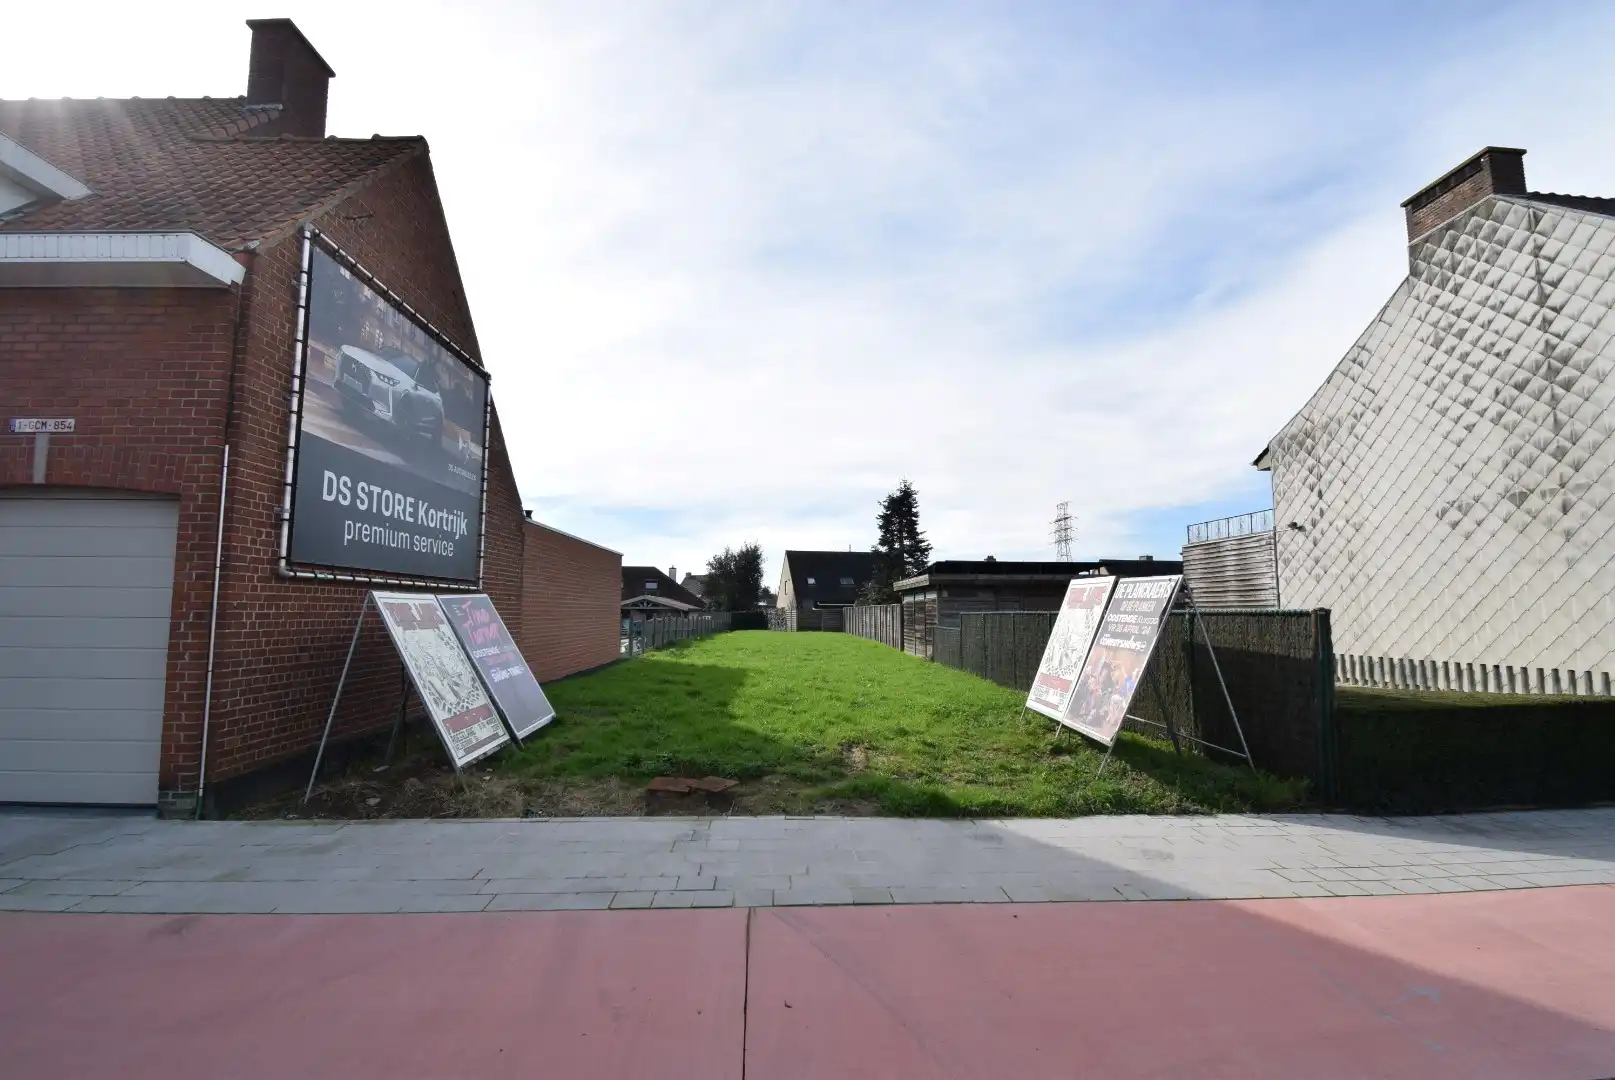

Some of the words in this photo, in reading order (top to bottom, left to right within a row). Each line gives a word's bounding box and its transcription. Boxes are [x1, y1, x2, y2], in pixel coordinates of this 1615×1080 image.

[322, 469, 352, 506] DS
[356, 481, 415, 523] STORE
[418, 500, 468, 540] Kortrijk
[344, 519, 410, 549] premium
[413, 534, 454, 557] service
